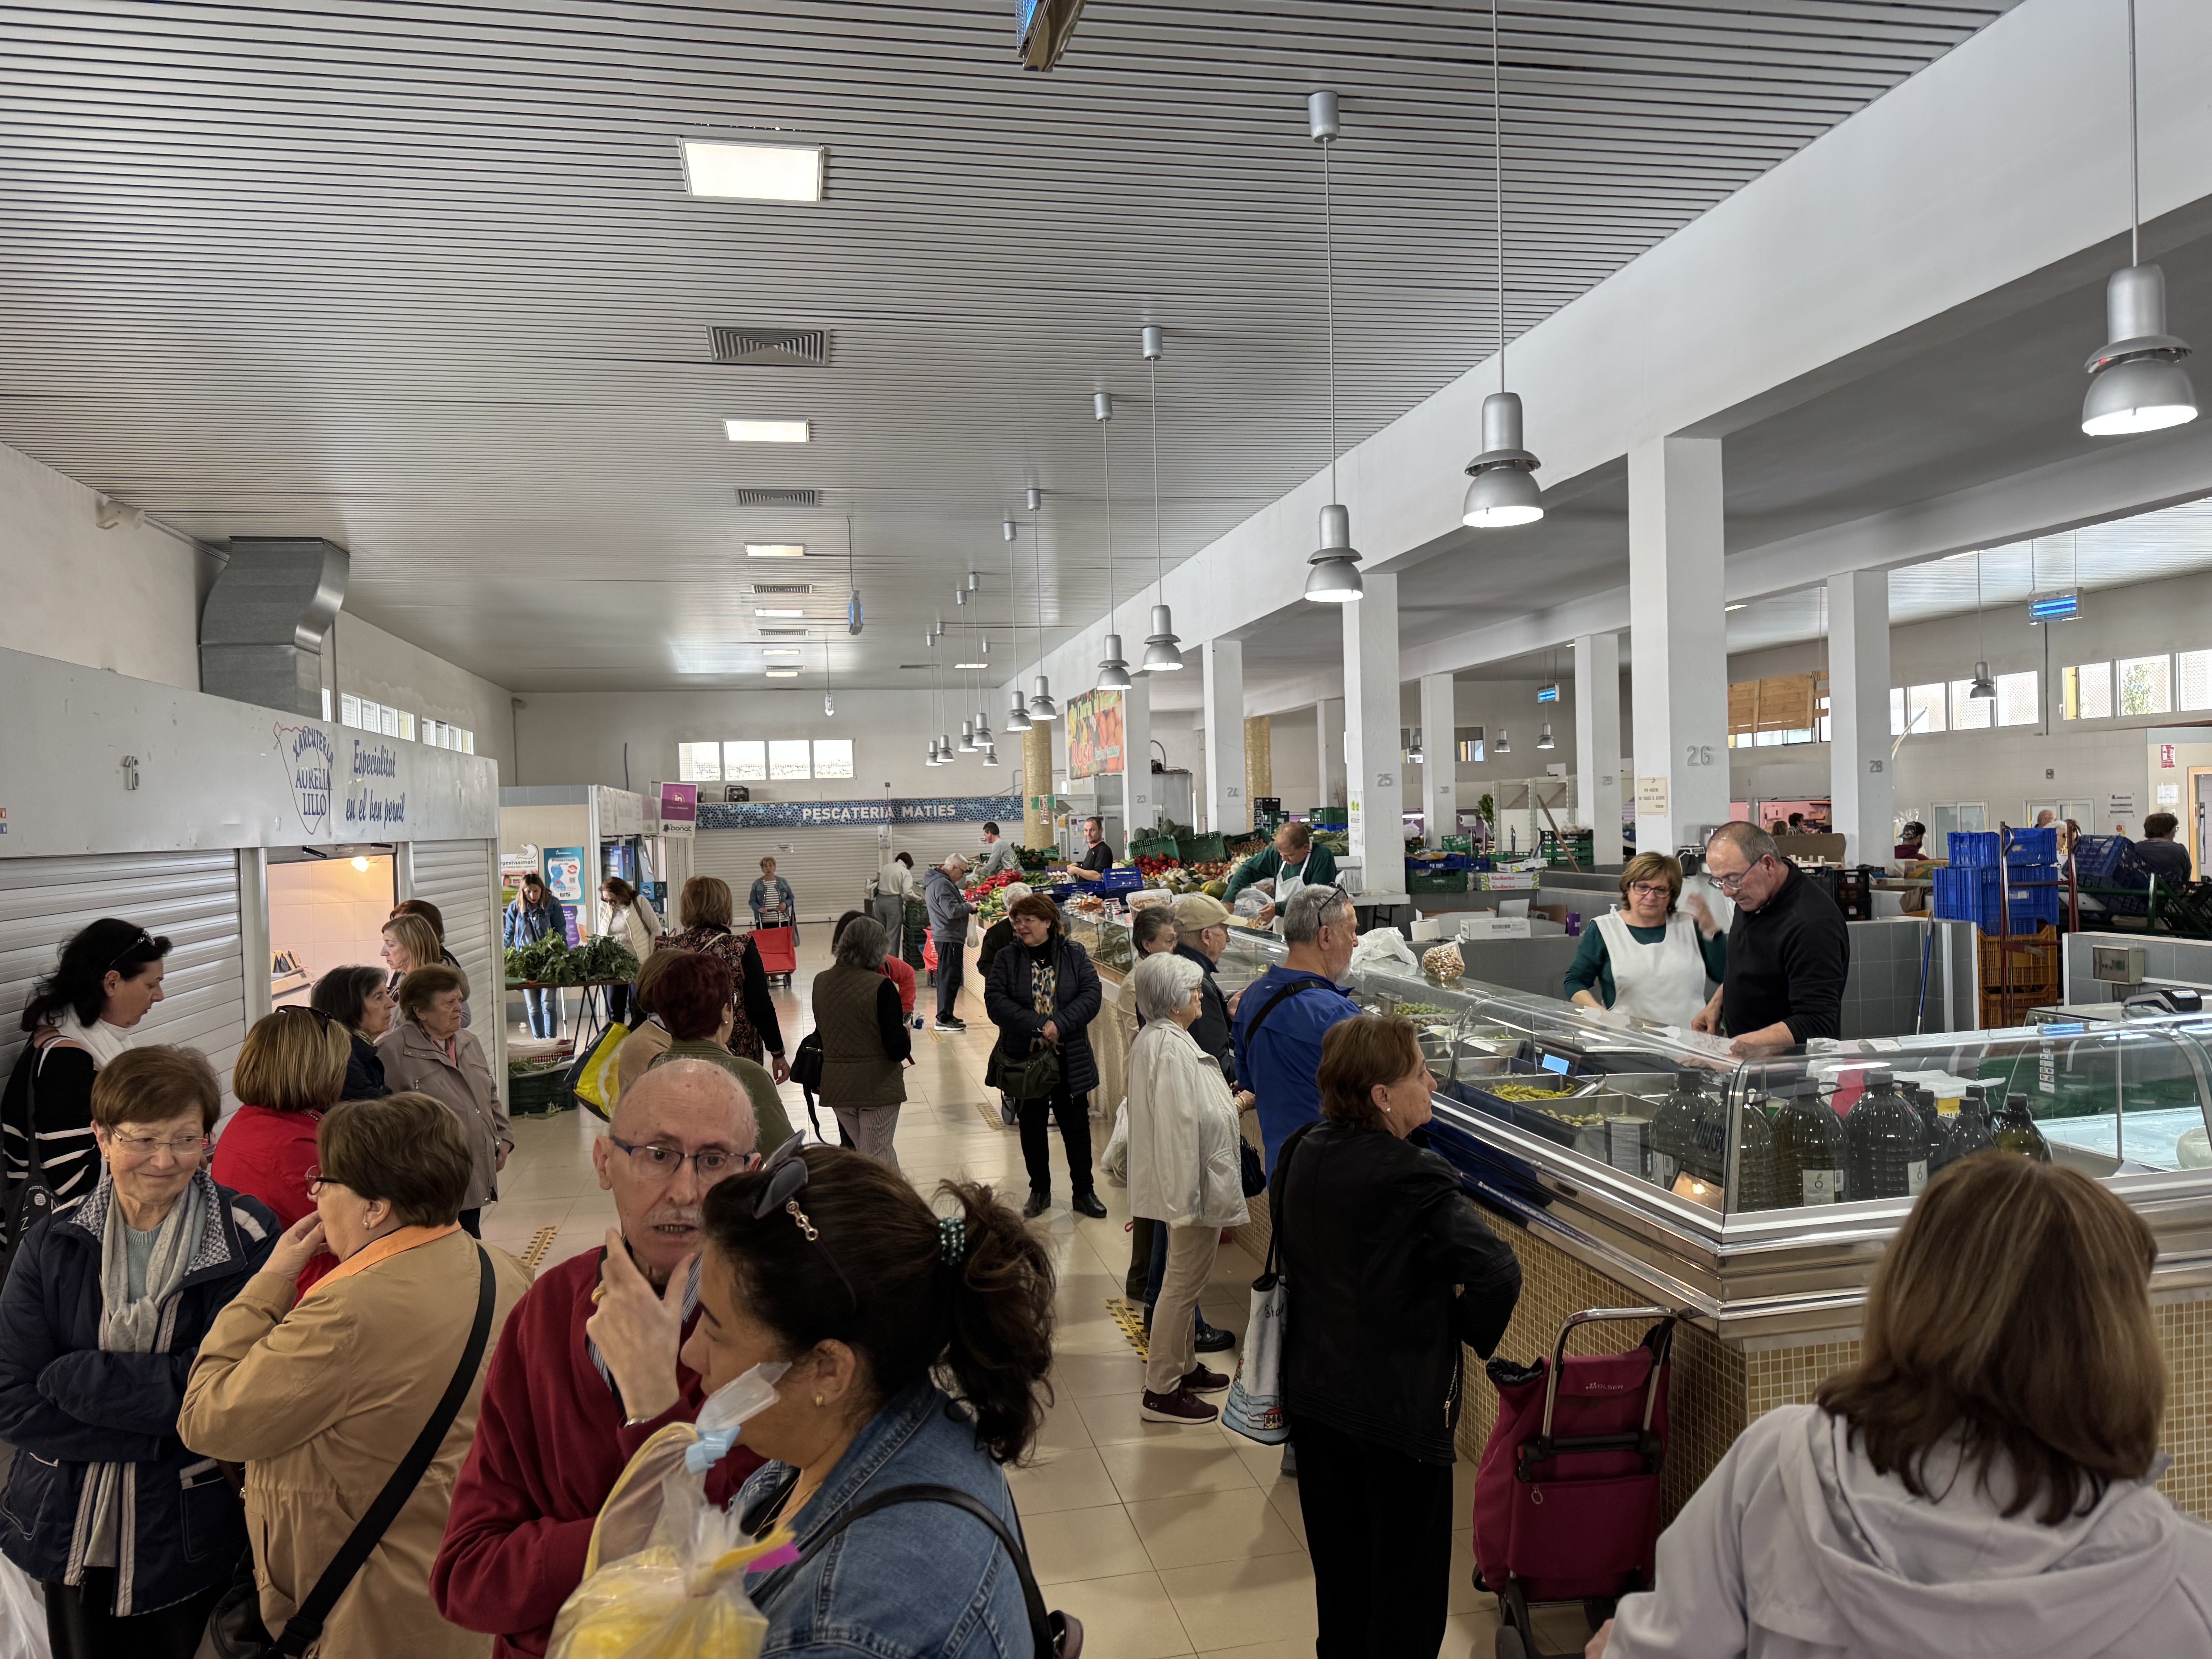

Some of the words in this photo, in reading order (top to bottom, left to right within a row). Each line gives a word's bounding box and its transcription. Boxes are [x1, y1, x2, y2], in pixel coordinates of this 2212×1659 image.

[293, 726, 333, 769] XARCUTERIA
[354, 739, 395, 778] Especialitat
[1686, 745, 1715, 766] 26
[122, 756, 139, 790] 16
[1869, 760, 1883, 773] 28
[295, 767, 333, 790] AURELIA
[1377, 773, 1393, 787] 25
[302, 793, 326, 816] LILLO
[346, 798, 356, 821] en
[359, 787, 367, 821] el
[383, 792, 405, 830] pernil
[1137, 795, 1146, 803] 23
[803, 807, 895, 820] PESCATERIA
[902, 805, 955, 817] MATIES
